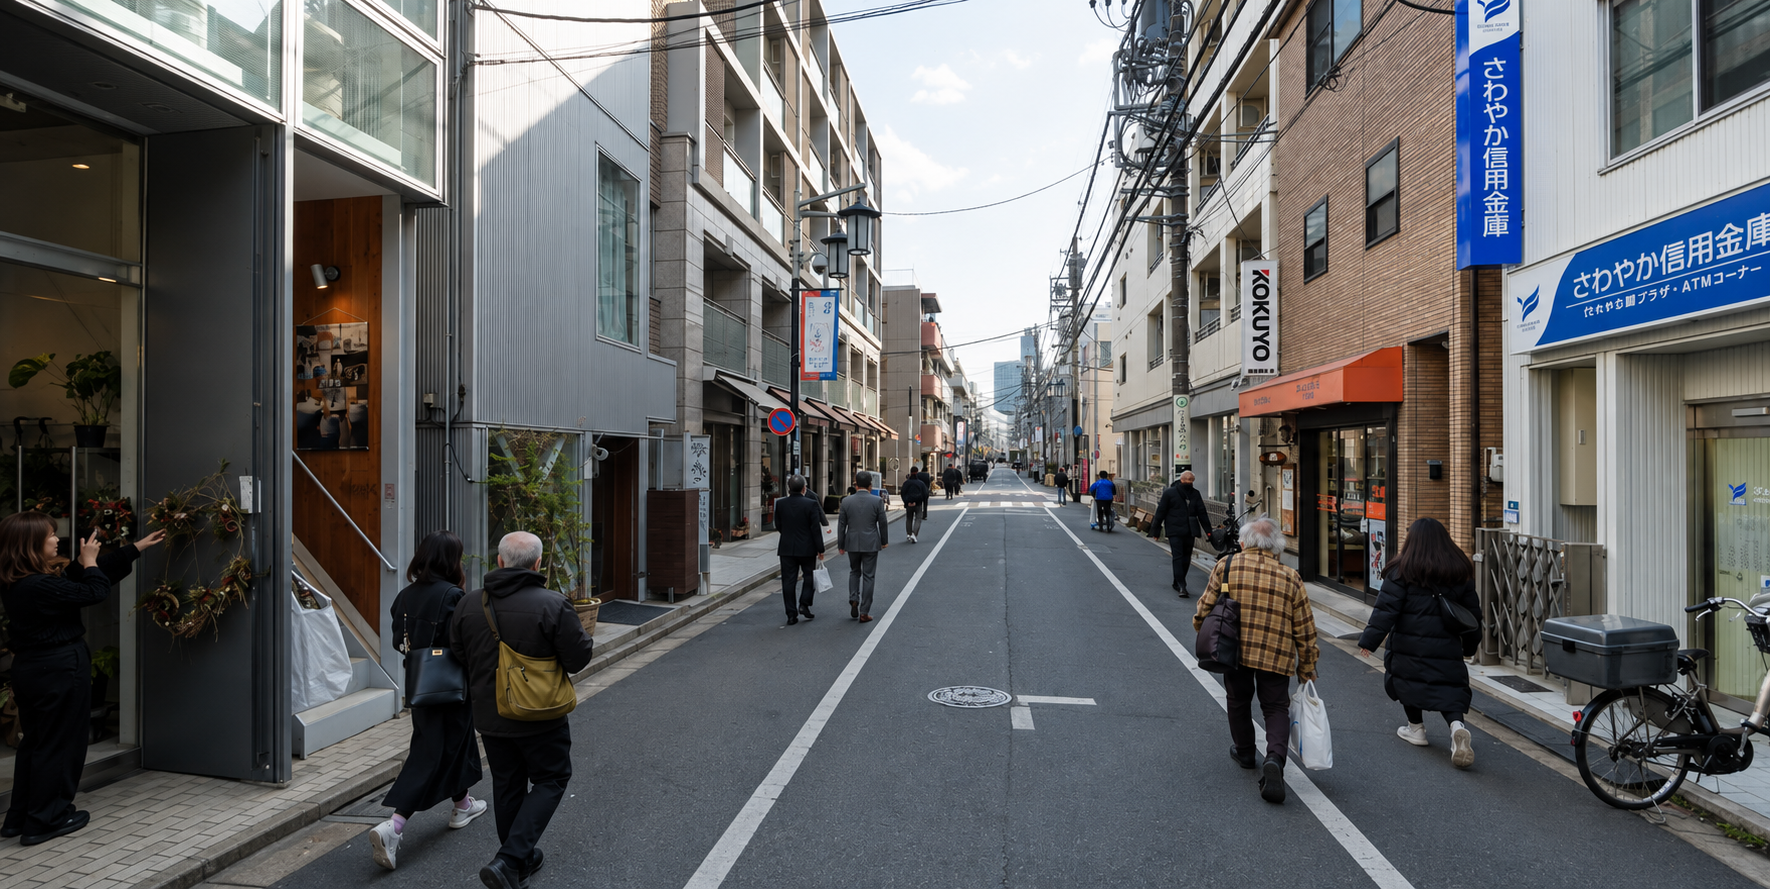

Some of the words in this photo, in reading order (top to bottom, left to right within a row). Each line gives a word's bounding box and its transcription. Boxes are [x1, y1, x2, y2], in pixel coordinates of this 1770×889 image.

[1483, 57, 1509, 237] さわやか信用金庫
[1573, 212, 1770, 299] さわやか信用金庫
[1252, 269, 1270, 362] KOKUYO
